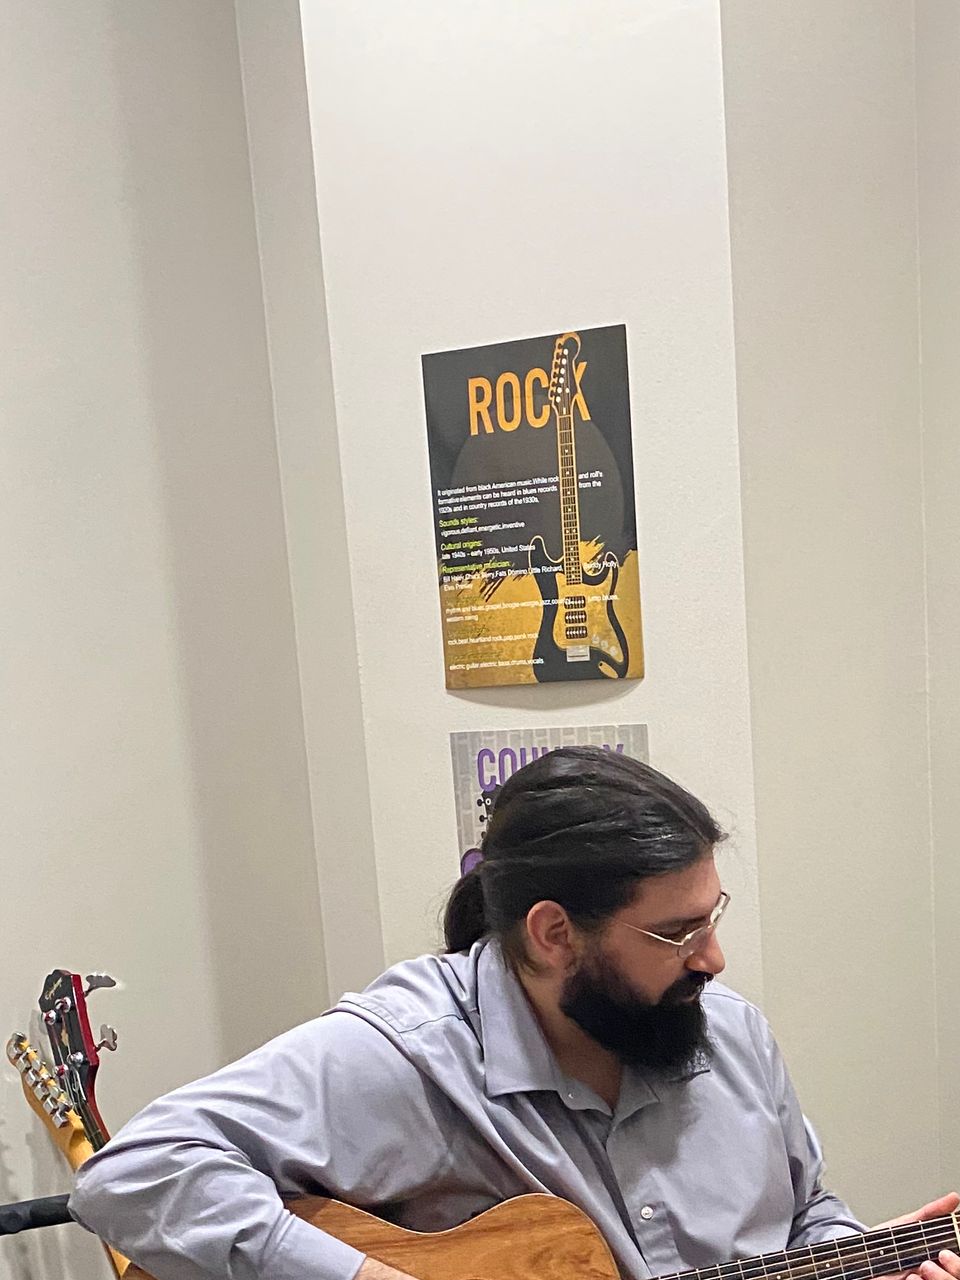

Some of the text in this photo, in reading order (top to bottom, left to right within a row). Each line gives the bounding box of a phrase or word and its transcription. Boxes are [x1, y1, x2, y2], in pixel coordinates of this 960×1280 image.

[468, 361, 591, 436] ROCK
[442, 486, 465, 496] originated
[478, 483, 491, 491] black
[492, 480, 516, 490] American
[578, 471, 588, 479] and
[460, 494, 482, 502] elements
[500, 490, 516, 498] heard
[522, 488, 537, 496] blues
[538, 485, 558, 494] records
[578, 480, 591, 488] from
[488, 500, 507, 508] records
[439, 518, 460, 528] Sounds
[441, 542, 462, 551] Cultural
[470, 549, 484, 557] early
[501, 544, 518, 553] United
[519, 544, 536, 552] States
